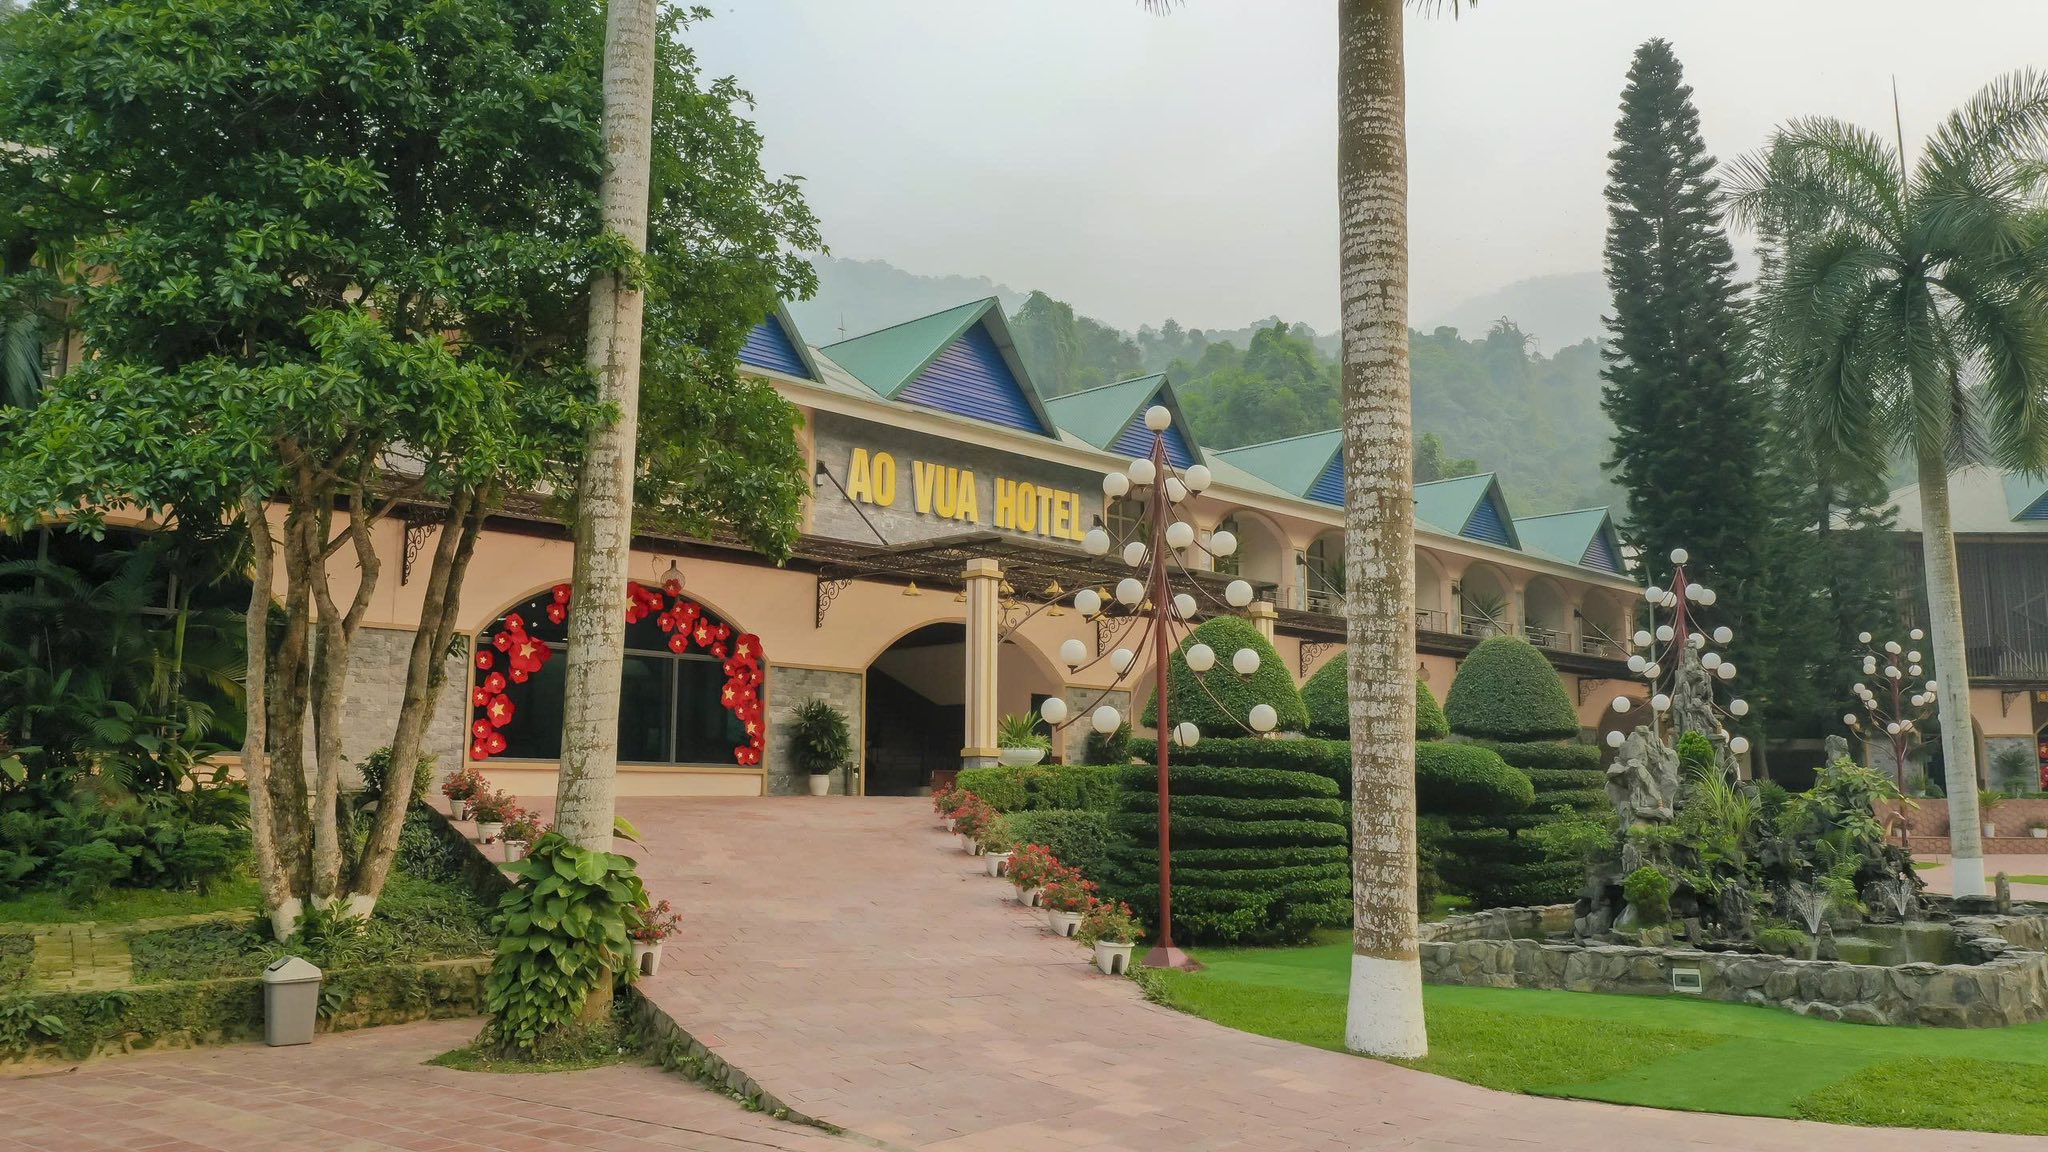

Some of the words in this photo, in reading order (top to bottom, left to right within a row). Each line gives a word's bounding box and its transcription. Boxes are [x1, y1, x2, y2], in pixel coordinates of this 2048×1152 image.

[847, 447, 897, 507] AO
[911, 460, 979, 524] VUA
[994, 477, 1086, 542] HOTEL
